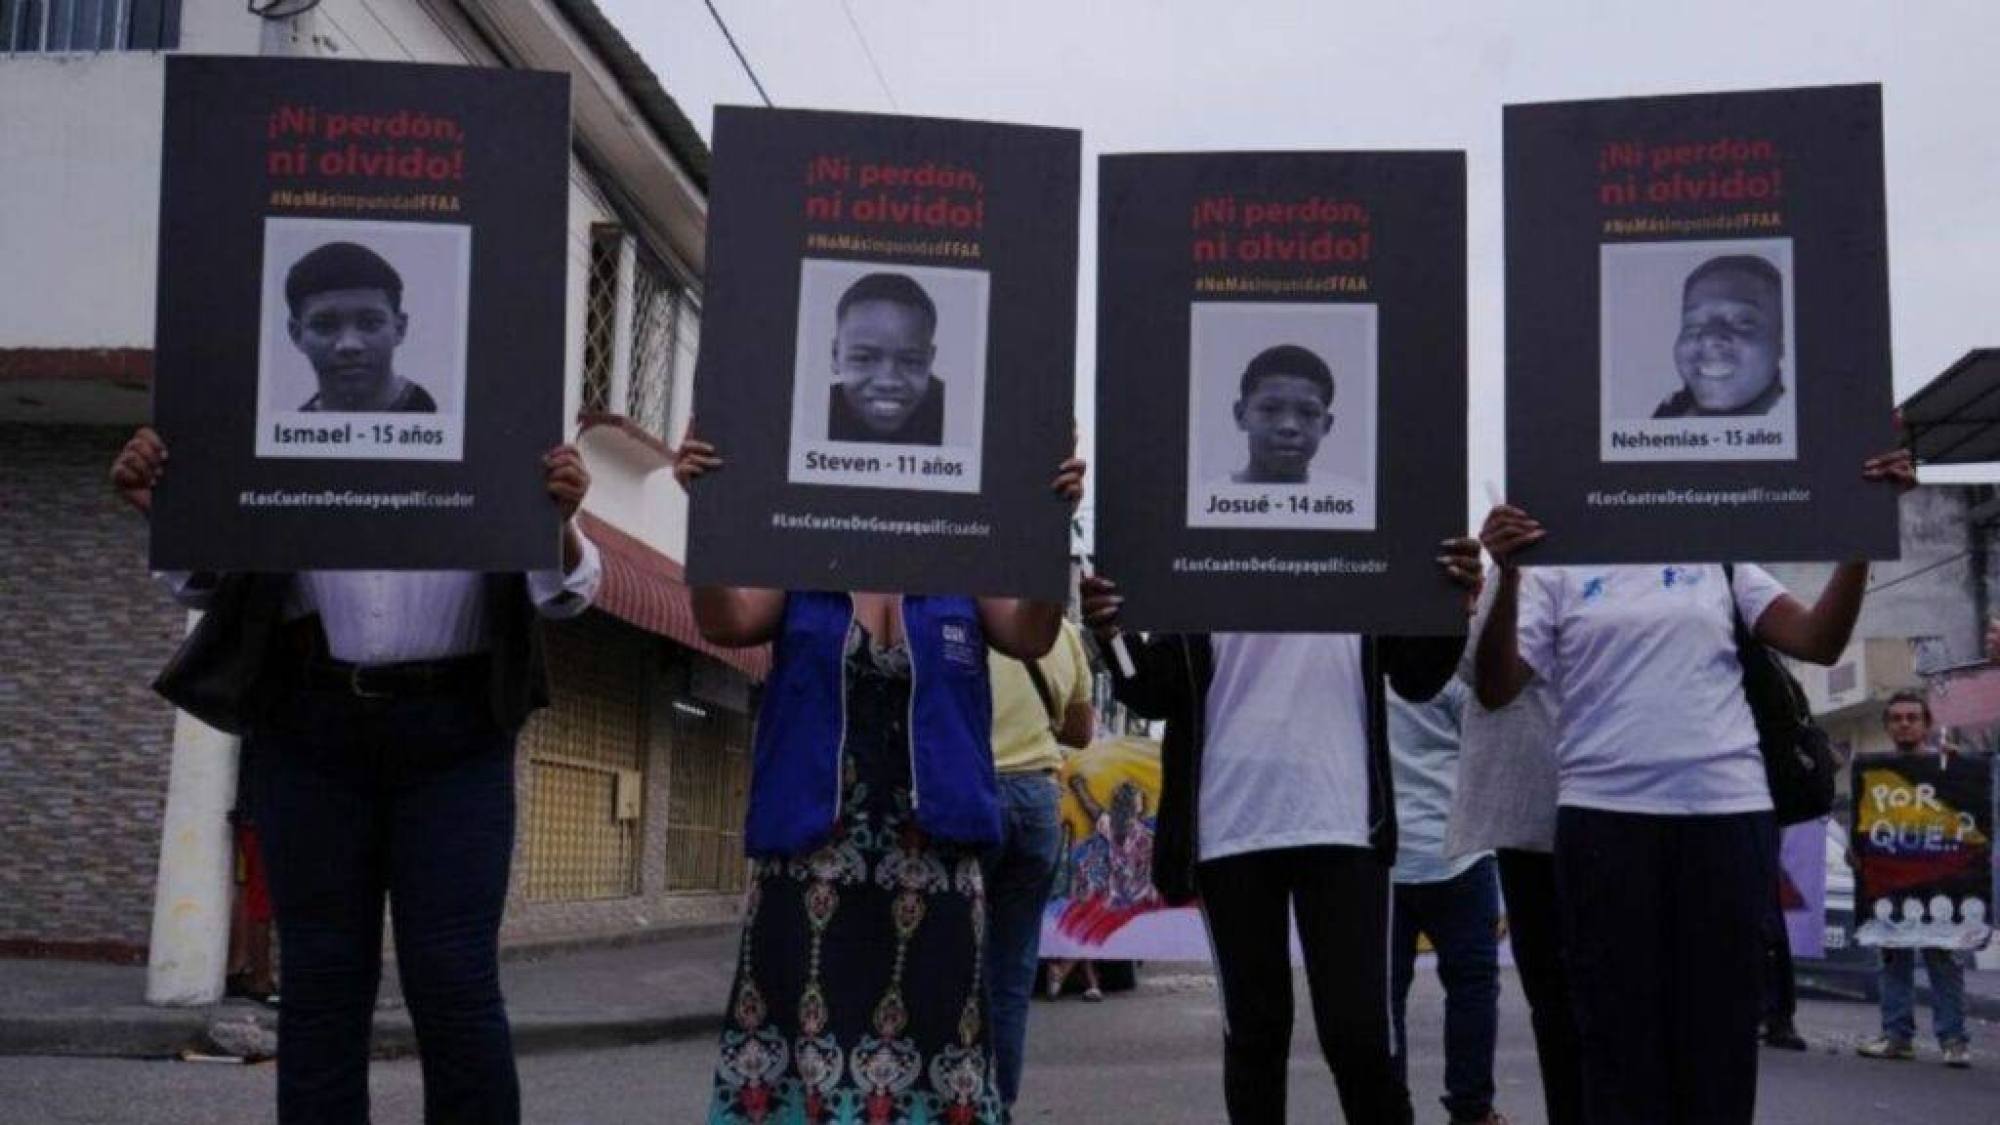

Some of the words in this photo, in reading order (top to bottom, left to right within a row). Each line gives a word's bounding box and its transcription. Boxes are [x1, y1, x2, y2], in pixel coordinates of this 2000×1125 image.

[326, 111, 464, 143] perdón,
[268, 144, 306, 176] ni
[319, 146, 464, 181] olvido!
[1651, 136, 1778, 171] perdón
[859, 161, 983, 193] perdón,
[1600, 176, 1636, 204] ni
[1650, 168, 1782, 202] olvido!
[806, 192, 841, 219] ni
[854, 195, 983, 229] olvido!
[1245, 197, 1369, 227] perdón,
[1193, 232, 1226, 261] ni
[1239, 231, 1371, 263] olvido!
[274, 424, 351, 444] Ismael
[372, 425, 393, 444] 15
[399, 426, 443, 445] años
[1611, 430, 1708, 448] Nehemías
[1726, 430, 1743, 446] 15
[1746, 428, 1782, 445] años
[806, 451, 880, 472] Steven
[897, 456, 916, 473] 11
[922, 457, 963, 476] años
[1207, 495, 1269, 514] Josué
[1290, 497, 1309, 514] 14
[1314, 496, 1354, 514] años
[1873, 783, 1943, 812] POR
